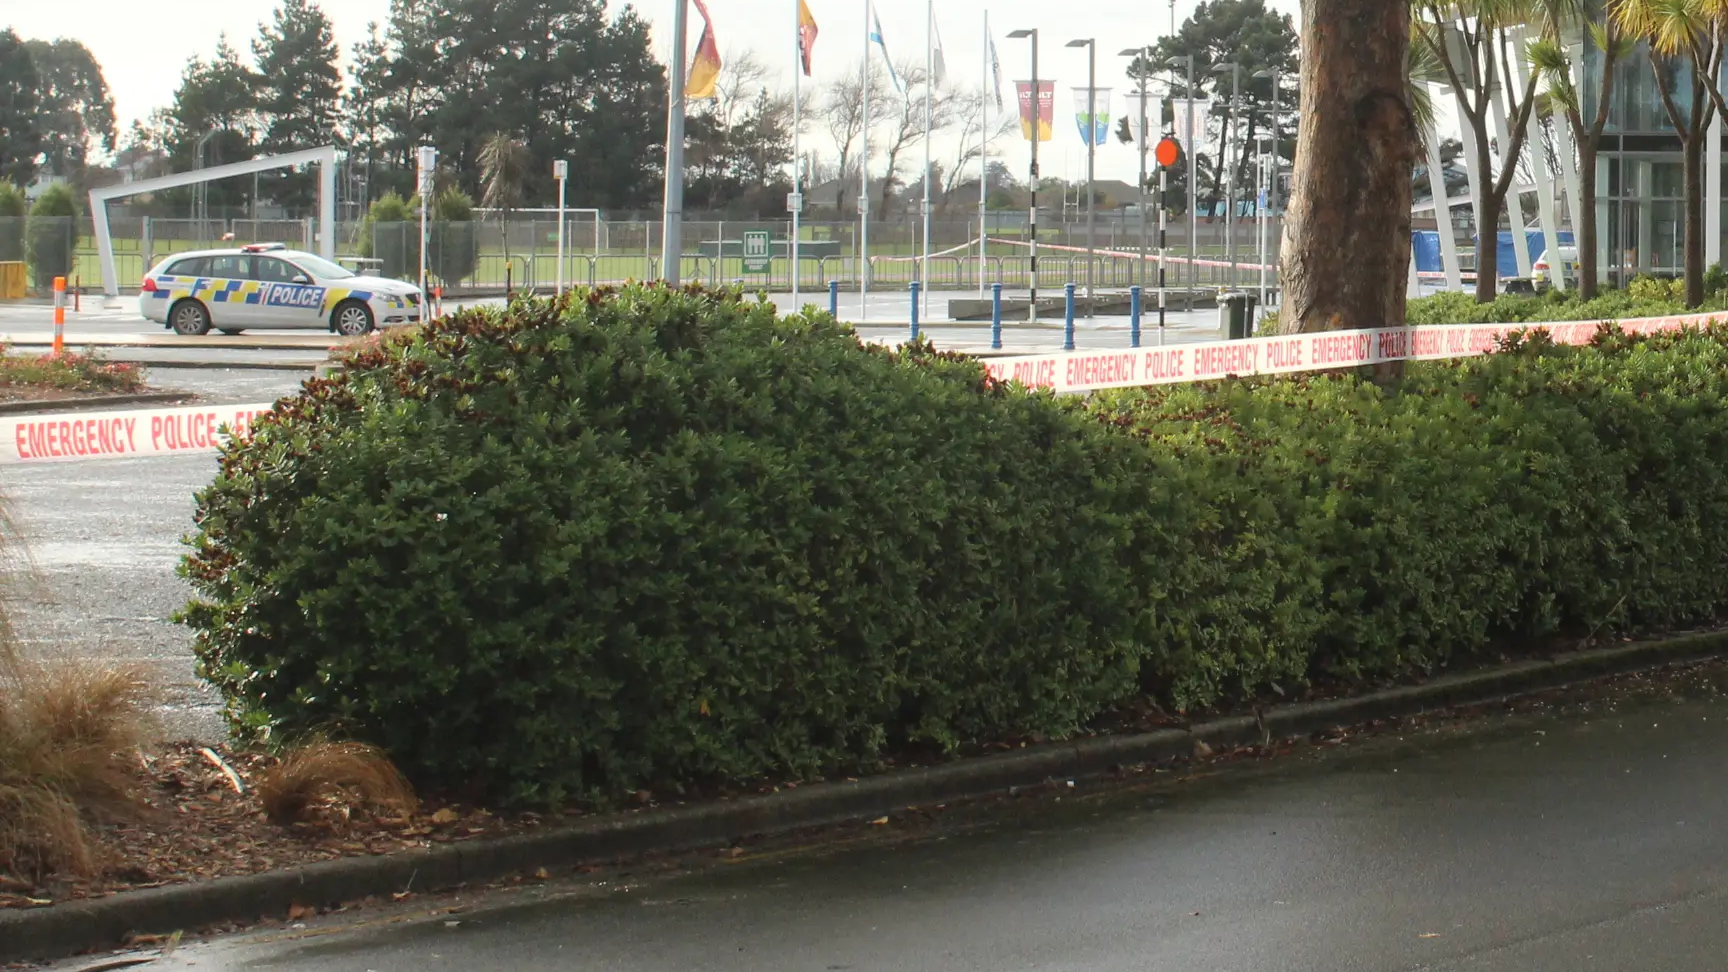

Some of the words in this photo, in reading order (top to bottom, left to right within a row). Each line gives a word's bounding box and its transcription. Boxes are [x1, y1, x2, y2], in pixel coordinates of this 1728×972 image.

[272, 286, 322, 307] POLICE
[1066, 354, 1137, 386] EMERGENCY
[1145, 350, 1184, 379] POLICE
[1194, 344, 1259, 375] EMERGENCY
[1266, 340, 1302, 368] POLICE
[1311, 334, 1372, 364] EMERGENCY
[15, 417, 137, 459] EMERGENCY
[151, 412, 218, 451] POLICE
